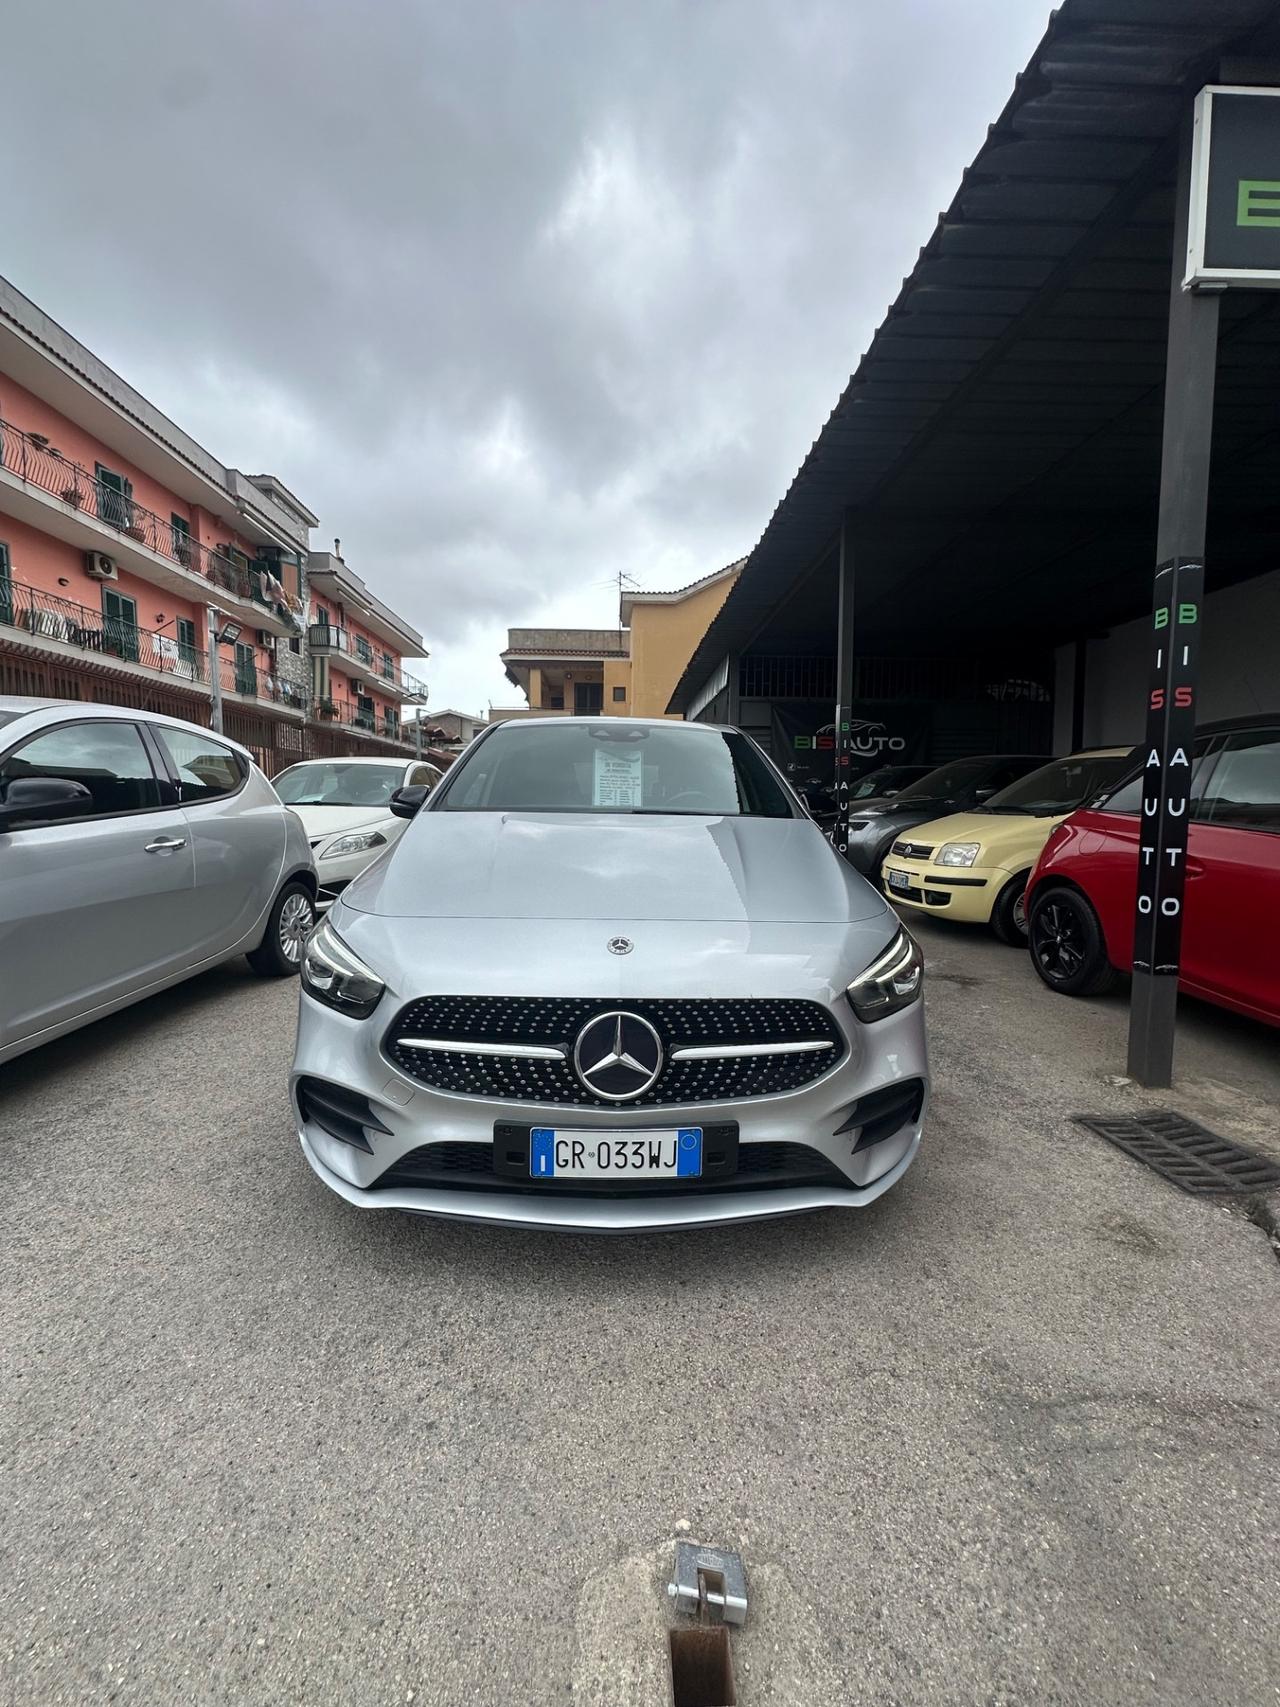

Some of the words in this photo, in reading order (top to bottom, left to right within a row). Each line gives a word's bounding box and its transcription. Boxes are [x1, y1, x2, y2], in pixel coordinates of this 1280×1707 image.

[1150, 607, 1168, 709] BIS
[1175, 603, 1197, 707] BIS
[794, 735, 834, 749] BIS
[1138, 749, 1160, 914] AUTO
[1161, 748, 1189, 916] AUTO
